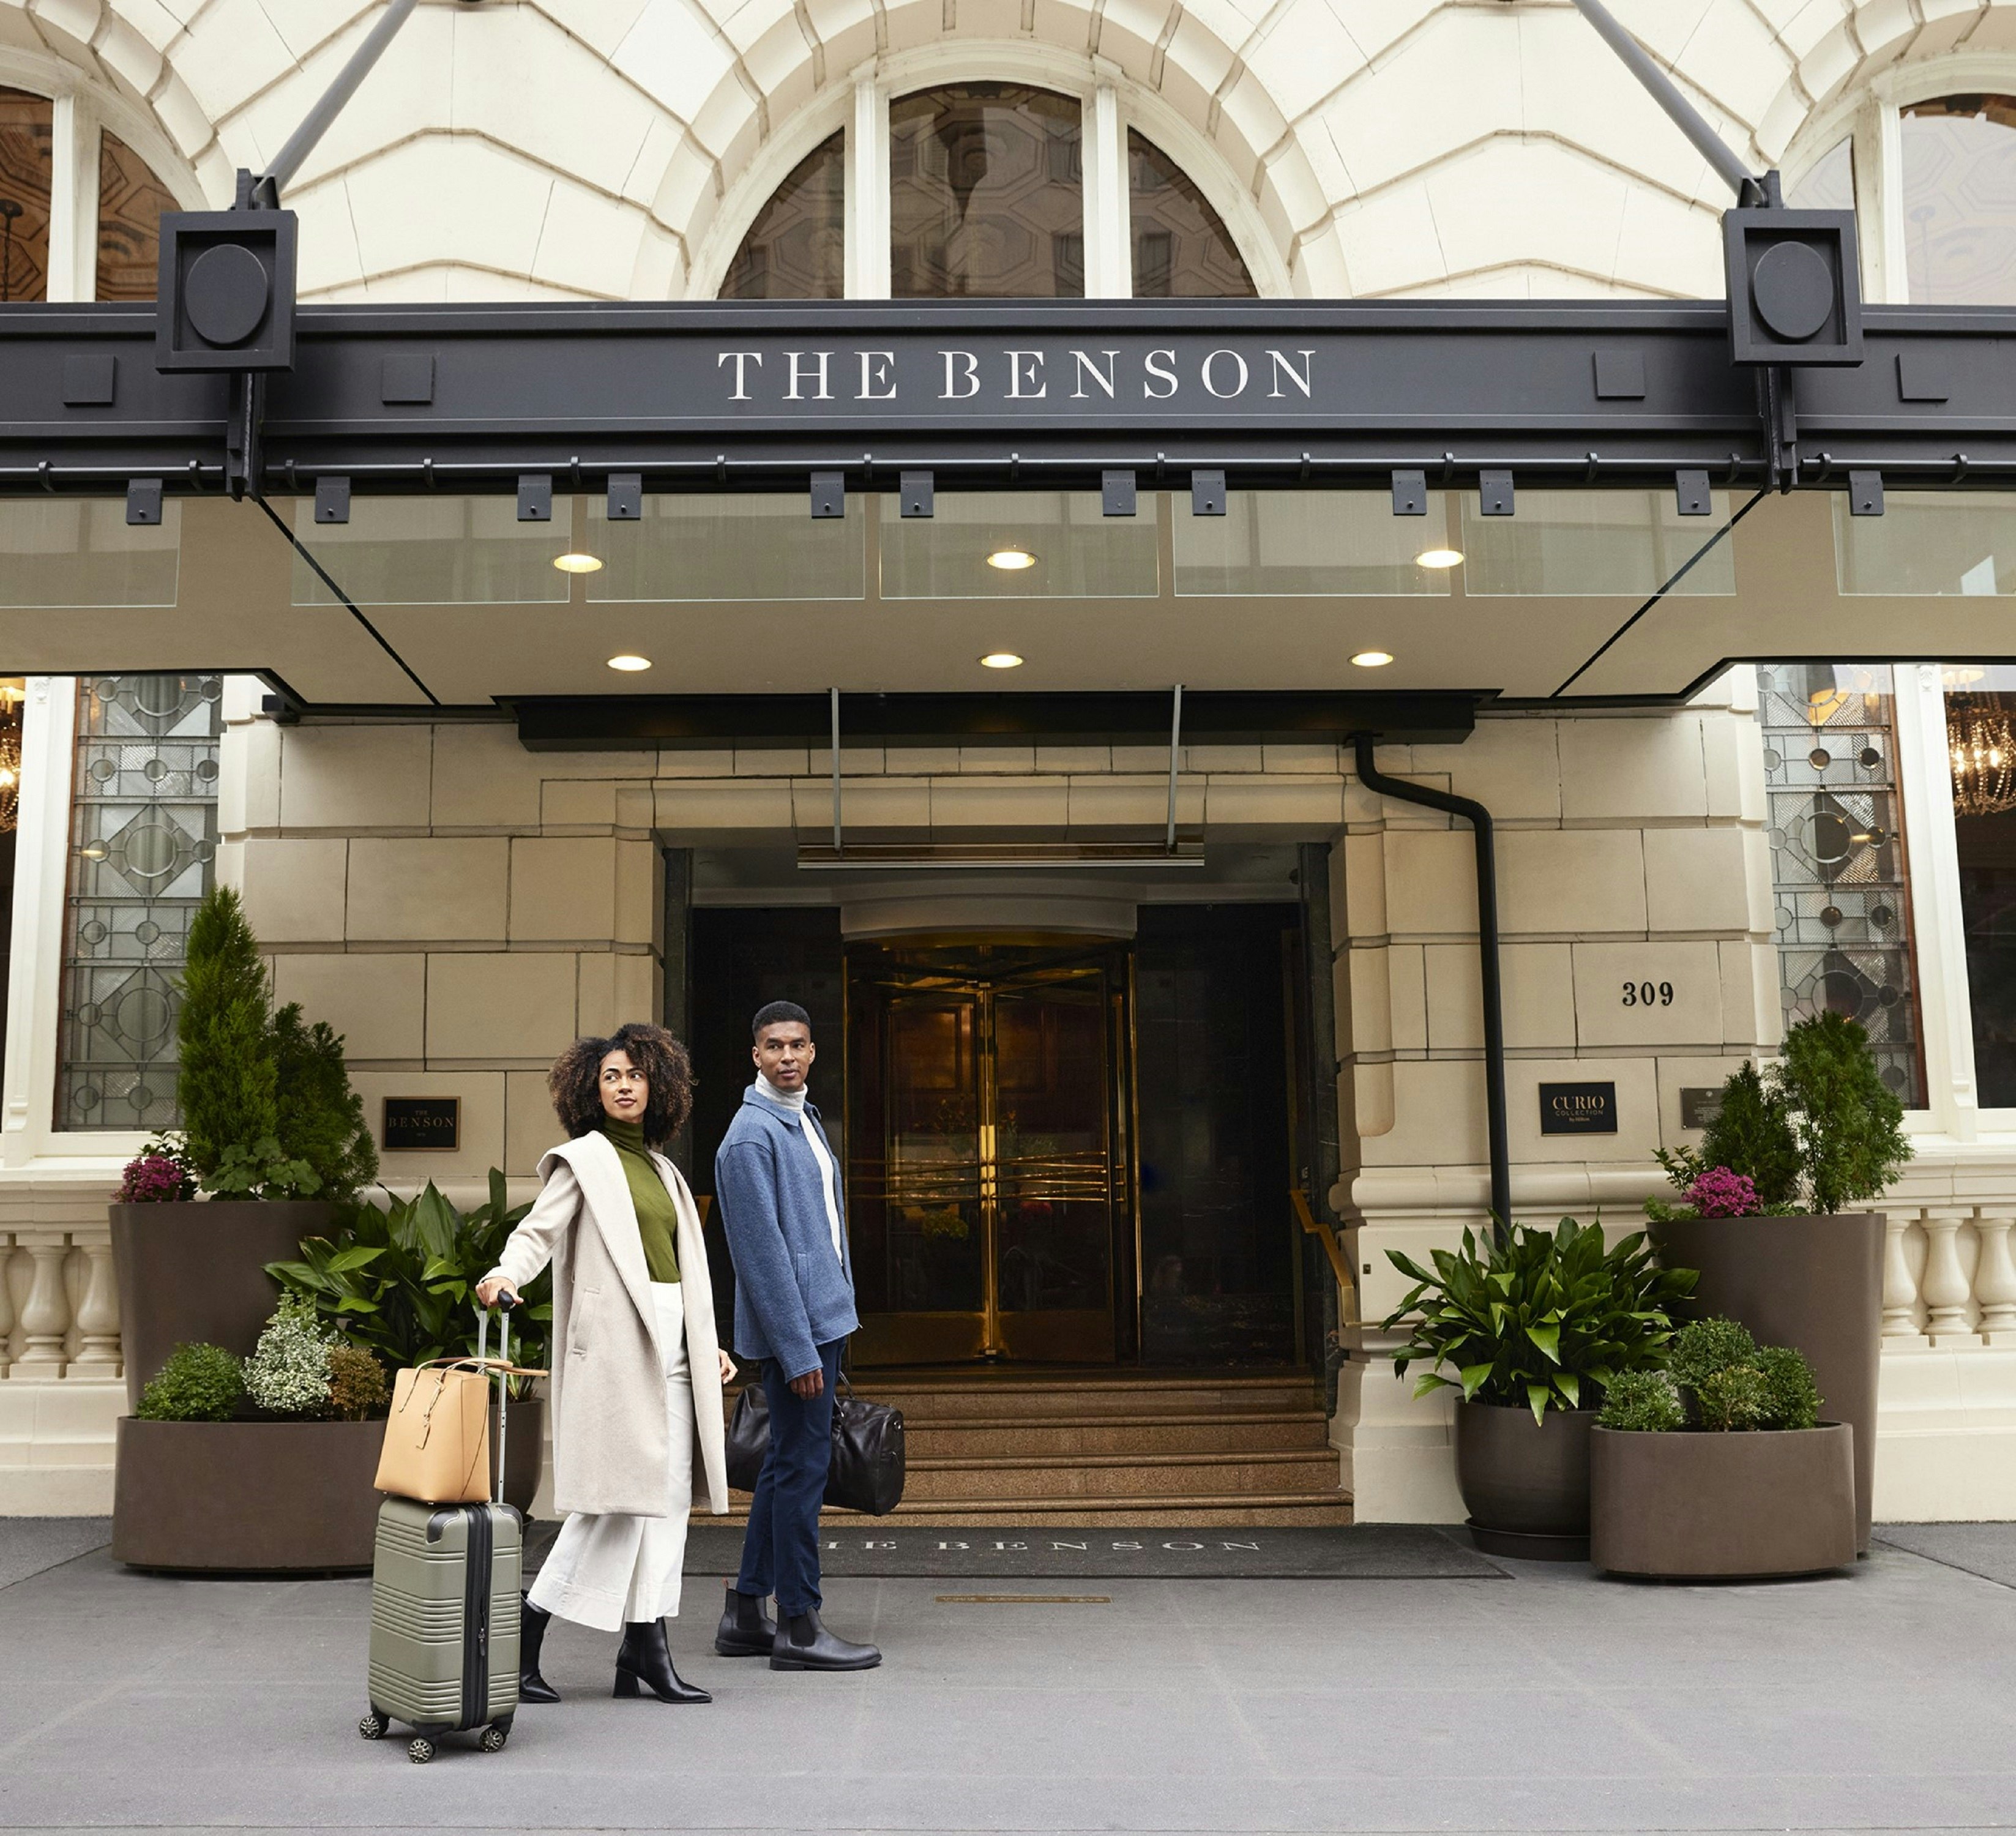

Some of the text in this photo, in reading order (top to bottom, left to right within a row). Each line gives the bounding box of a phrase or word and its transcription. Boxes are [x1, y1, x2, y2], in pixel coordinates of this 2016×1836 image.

[718, 349, 1316, 400] THE BENSON
[1622, 981, 1673, 1006] 309
[1552, 1095, 1605, 1110] CURIO
[388, 1116, 454, 1128] BENSON
[817, 1541, 1260, 1551] HE BENSON
